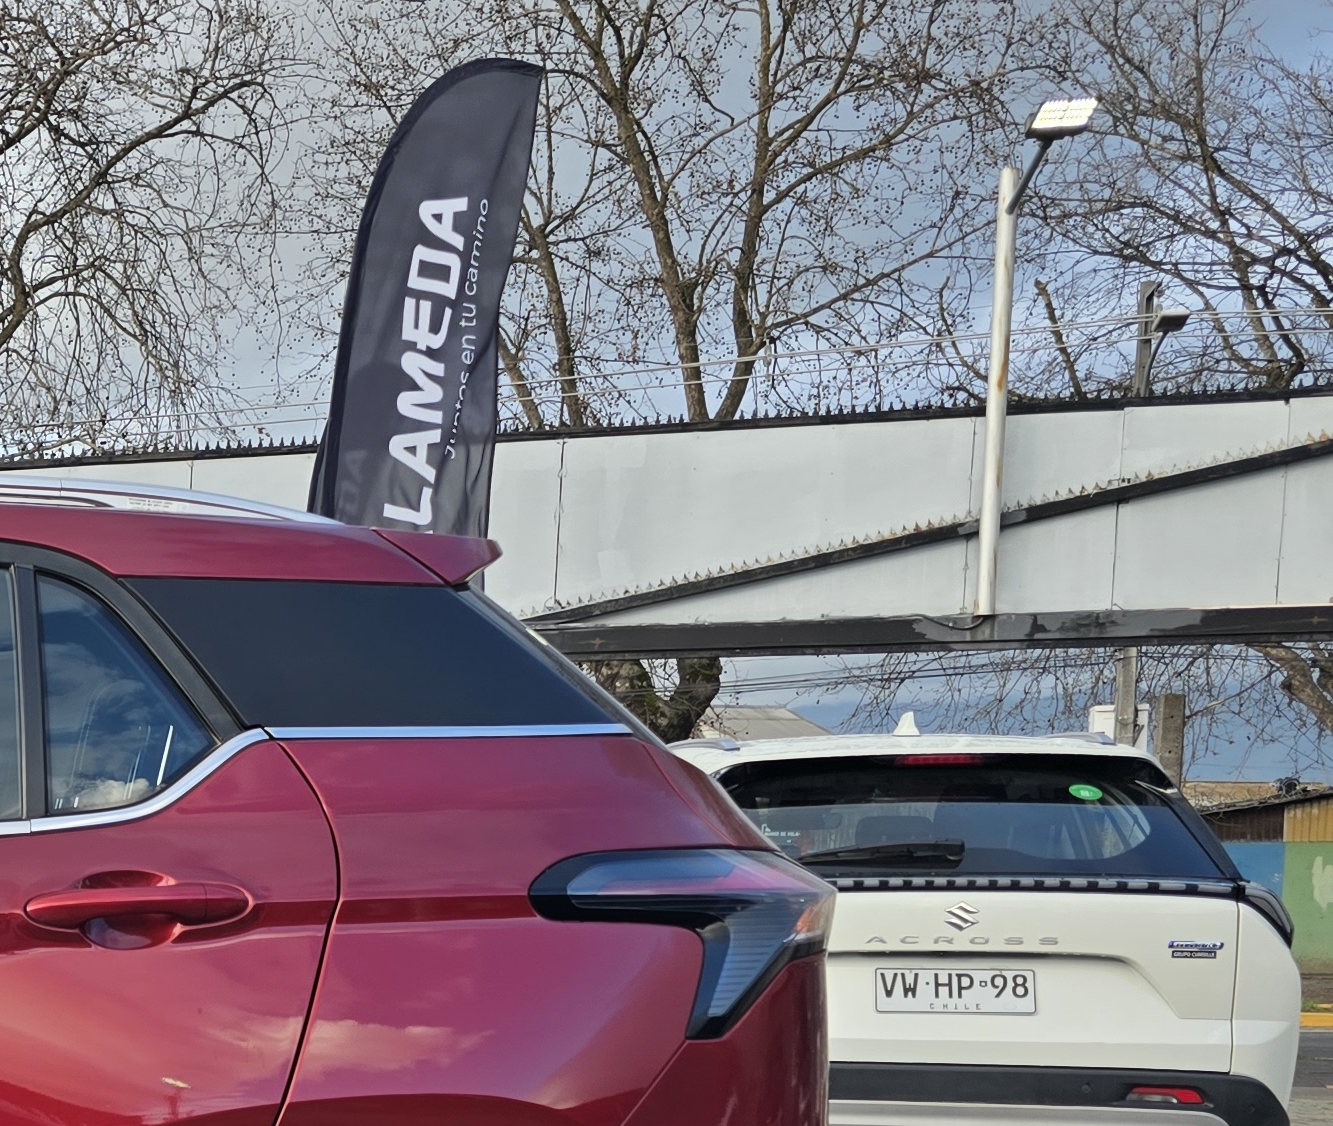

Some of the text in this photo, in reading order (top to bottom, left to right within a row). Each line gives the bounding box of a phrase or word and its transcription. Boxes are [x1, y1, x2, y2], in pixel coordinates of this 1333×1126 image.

[464, 198, 489, 296] camino
[460, 303, 476, 328] tu
[383, 196, 468, 527] LAMEDA
[461, 334, 477, 365] en
[865, 935, 1059, 946] ACROSS
